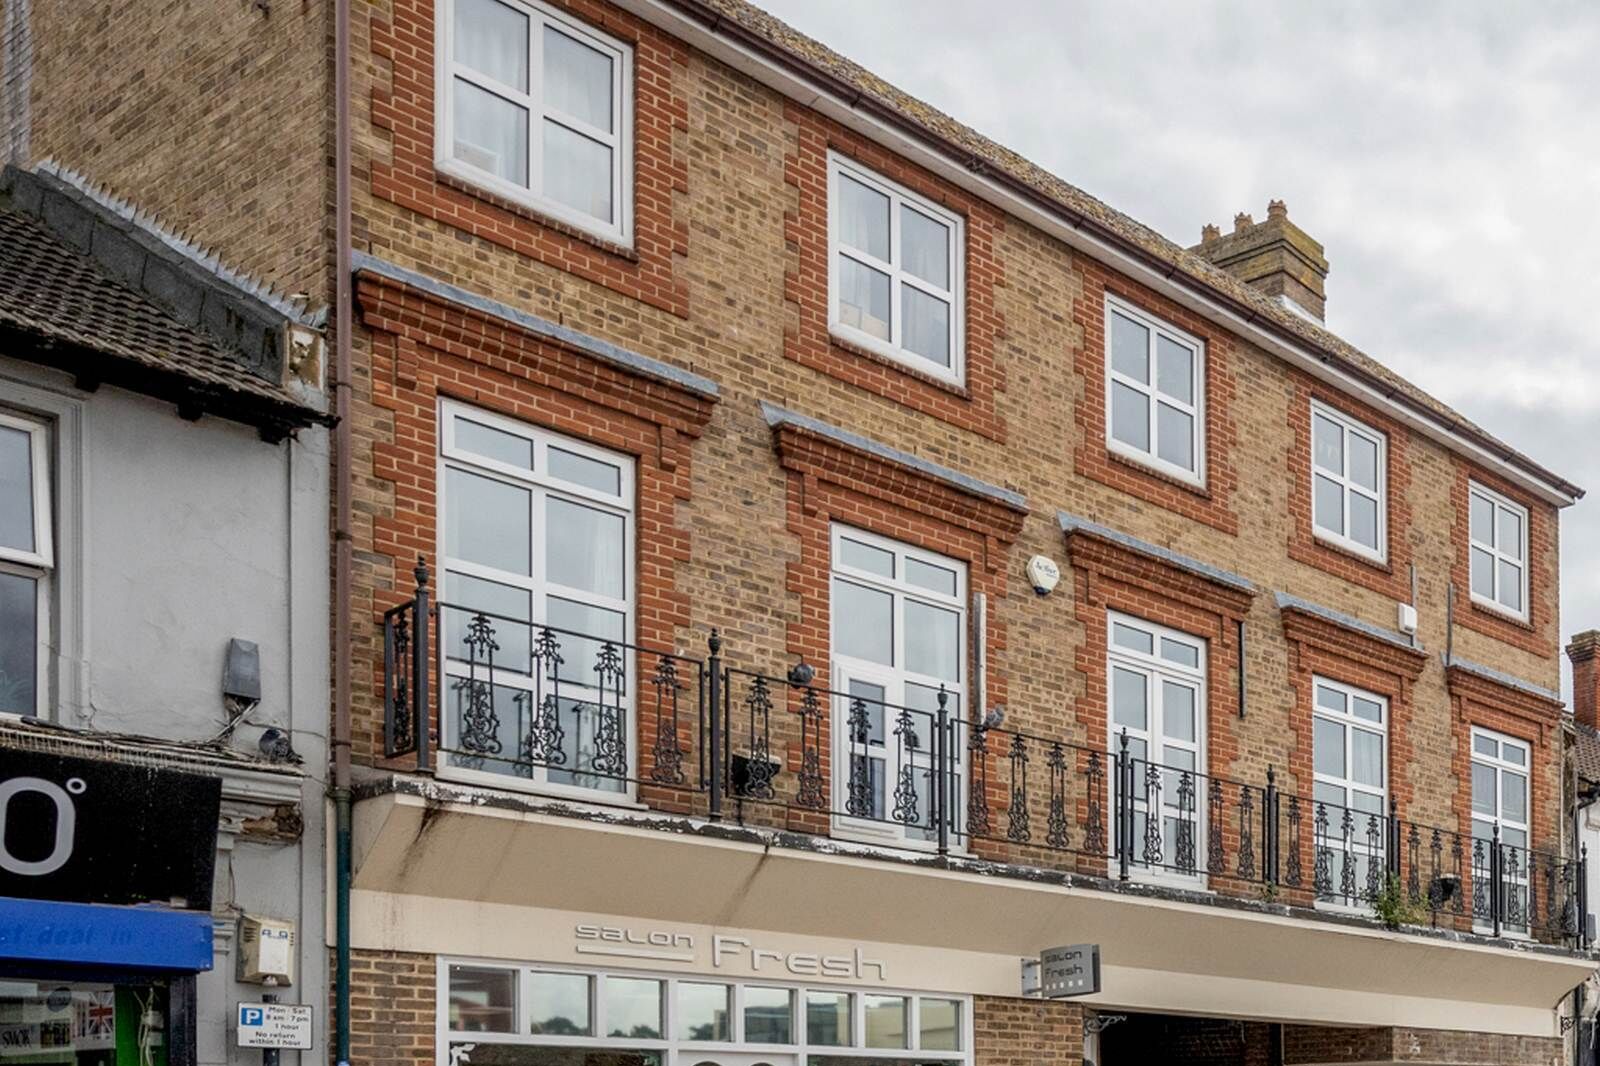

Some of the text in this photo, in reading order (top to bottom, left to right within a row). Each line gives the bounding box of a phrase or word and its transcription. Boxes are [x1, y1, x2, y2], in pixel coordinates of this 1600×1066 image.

[574, 923, 888, 981] salon Fresh
[1045, 964, 1084, 978] Fresh
[246, 1009, 260, 1025] P
